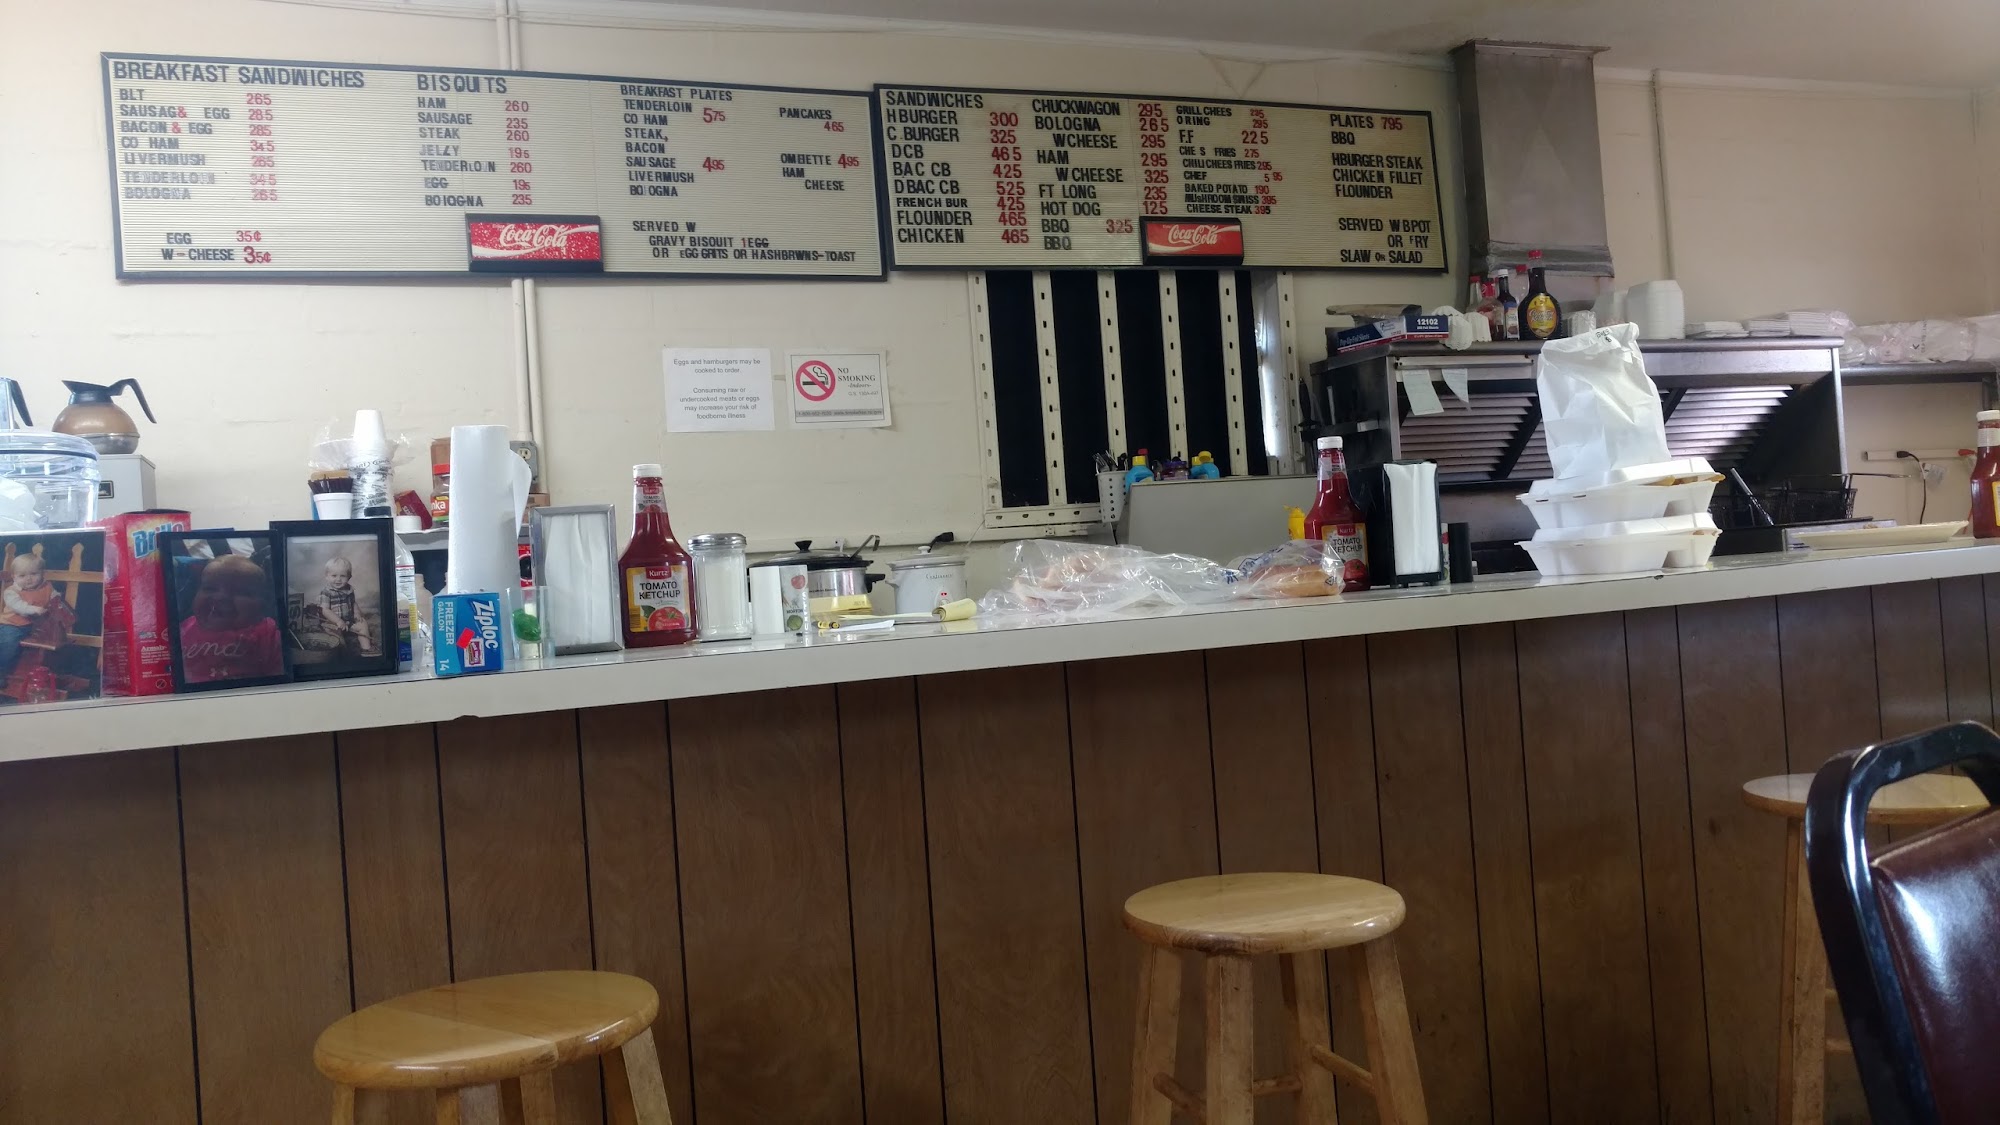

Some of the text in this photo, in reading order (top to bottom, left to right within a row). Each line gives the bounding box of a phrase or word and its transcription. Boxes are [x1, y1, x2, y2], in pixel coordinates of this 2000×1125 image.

[114, 61, 364, 88] BREAKFAST SANDWICHES
[120, 89, 144, 100] BLT
[620, 84, 732, 101] BREAKFAST PLATES
[886, 90, 984, 108] SANDWICHES
[246, 93, 272, 106] 265
[418, 97, 446, 108] HAM
[505, 100, 529, 112] 260
[624, 100, 692, 113] TENDERLOIN
[1032, 99, 1120, 116] CHUCKWAGON
[1138, 102, 1162, 118] 295
[1176, 106, 1232, 116] GRILL CHEES
[204, 107, 230, 120] EGG
[248, 109, 273, 121] 285
[418, 112, 472, 124] SAUSAGE
[624, 113, 668, 126] CO HAM
[702, 108, 726, 124] 575
[779, 108, 832, 120] PANCAKES
[990, 112, 1018, 126] 300
[120, 120, 212, 134] BACON & EGG
[506, 118, 528, 130] 235
[824, 121, 844, 132] 465
[1034, 116, 1101, 132] BOLOGNA
[1140, 118, 1169, 132] 265
[1330, 114, 1403, 130] PLATES 795
[249, 124, 272, 136] 285
[419, 128, 460, 139] STEAK
[506, 130, 530, 141] 260
[904, 127, 960, 142] BURGER
[121, 136, 180, 149] CO HAM
[990, 130, 1016, 144] 325
[1140, 134, 1166, 148] 295
[1242, 130, 1268, 144] 225
[1331, 131, 1355, 145] BBQ
[250, 140, 275, 152] 345
[625, 142, 666, 154] BACON
[1214, 148, 1236, 157] FRIES
[124, 152, 206, 166] LIVERMUSH
[508, 148, 530, 158] 195
[992, 146, 1022, 161] 465
[1037, 150, 1069, 164] HAM
[1141, 152, 1168, 167] 295
[1244, 148, 1260, 158] 275
[252, 156, 275, 168] 265
[421, 160, 496, 172] TENDERLOIN
[510, 162, 532, 173] 260
[626, 156, 676, 168] SAUSAGE
[702, 156, 725, 172] 495
[838, 154, 860, 168] 495
[1206, 160, 1232, 169] CHEES
[1234, 160, 1256, 170] FRIES
[1257, 161, 1272, 170] 295
[1386, 155, 1423, 170] STEAK
[782, 167, 804, 178] HAM
[893, 162, 951, 176] BAC CB
[993, 164, 1022, 178] 425
[1184, 171, 1207, 180] CHEF
[124, 171, 215, 184] TENDERLOIN
[628, 170, 694, 182] LIVERMUSH
[1144, 170, 1168, 184] 325
[1332, 168, 1422, 184] CHICKEN FILLET
[424, 178, 448, 188] EGG
[512, 179, 530, 190] 195
[805, 180, 845, 191] CHEESE
[940, 180, 960, 194] CB
[996, 181, 1026, 196] 525
[1184, 184, 1248, 194] BAKED POTATO
[1254, 185, 1270, 194] 190
[124, 187, 191, 200] BOLOGNA
[1038, 184, 1096, 198] FT LONG
[1144, 186, 1167, 200] 235
[1336, 184, 1393, 199] FLOUNDER
[512, 194, 532, 206] 235
[896, 198, 968, 208] FRENCH BUR
[996, 196, 1025, 210] 425
[1040, 202, 1100, 216] HOT DOG
[1142, 201, 1168, 214] 125
[1186, 204, 1270, 214] CHEESE STEAK 395
[897, 210, 972, 226] FLOUNDER
[998, 212, 1026, 226] 465
[632, 220, 696, 232] SERVED W
[1042, 219, 1070, 232] BBQ
[1106, 219, 1133, 234] 325
[1338, 218, 1383, 232] SERVED
[166, 232, 192, 244] EGG
[649, 236, 685, 246] GRAVY
[898, 228, 964, 243] CHICKEN
[1002, 229, 1030, 244] 465
[1388, 234, 1403, 248] OR
[1044, 236, 1072, 250] BBQ
[652, 247, 748, 260] OR EGG GRITS OR
[1340, 249, 1422, 264] SLAW SALAD
[1333, 537, 1360, 545] TOMATO
[640, 581, 678, 590] TOMATO
[639, 590, 680, 600] KETCHUP
[445, 602, 454, 645] FREEZER
[473, 601, 498, 649] Ziploc
[440, 659, 450, 670] 14
